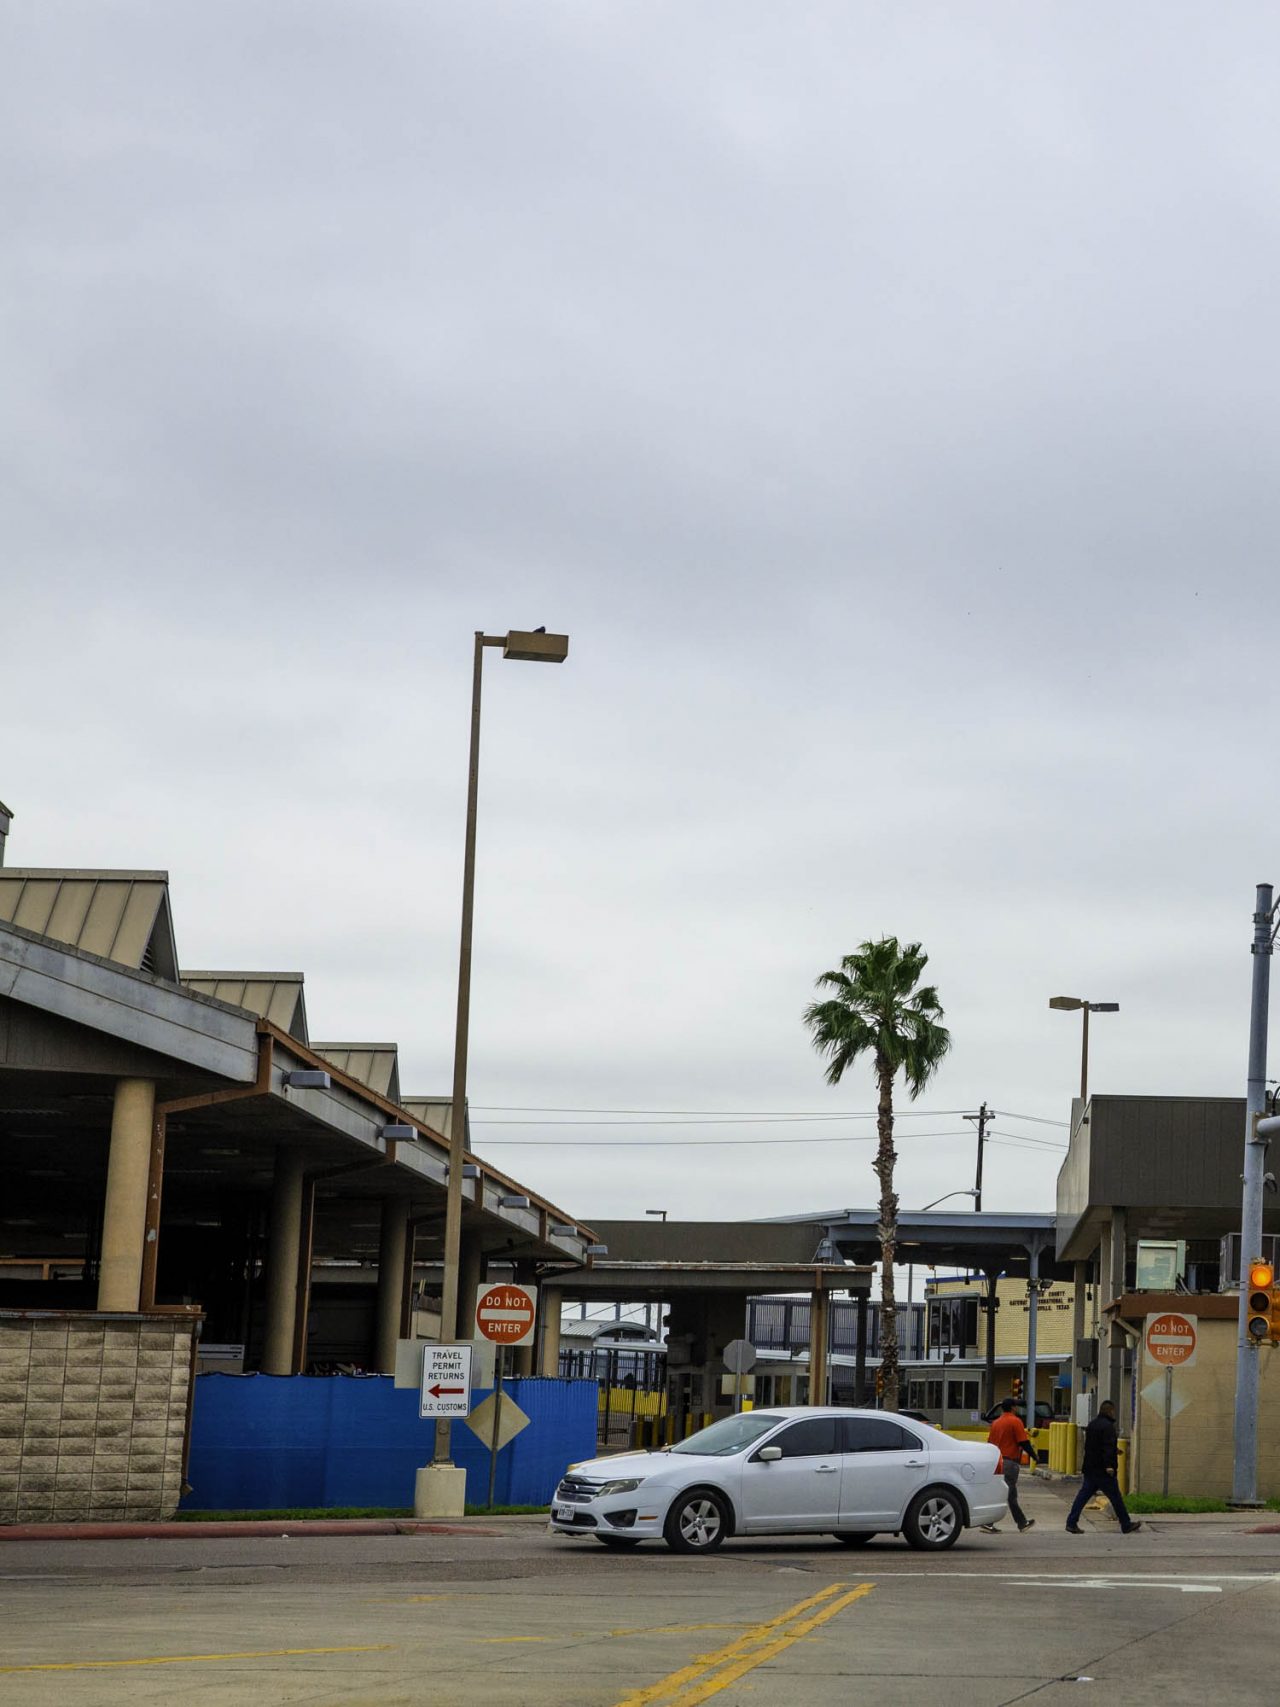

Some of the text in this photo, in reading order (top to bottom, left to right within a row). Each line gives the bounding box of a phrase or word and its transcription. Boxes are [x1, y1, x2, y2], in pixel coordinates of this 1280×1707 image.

[486, 1296, 527, 1307] DO NOT
[488, 1322, 521, 1333] ENTER
[1154, 1324, 1189, 1334] DO NOT
[1156, 1346, 1185, 1356] ENTER
[432, 1352, 463, 1360] TRAVEL
[432, 1362, 462, 1370] PERMIT
[428, 1372, 465, 1380] RETURNS
[423, 1403, 467, 1411] U.S. CUSTOMS
